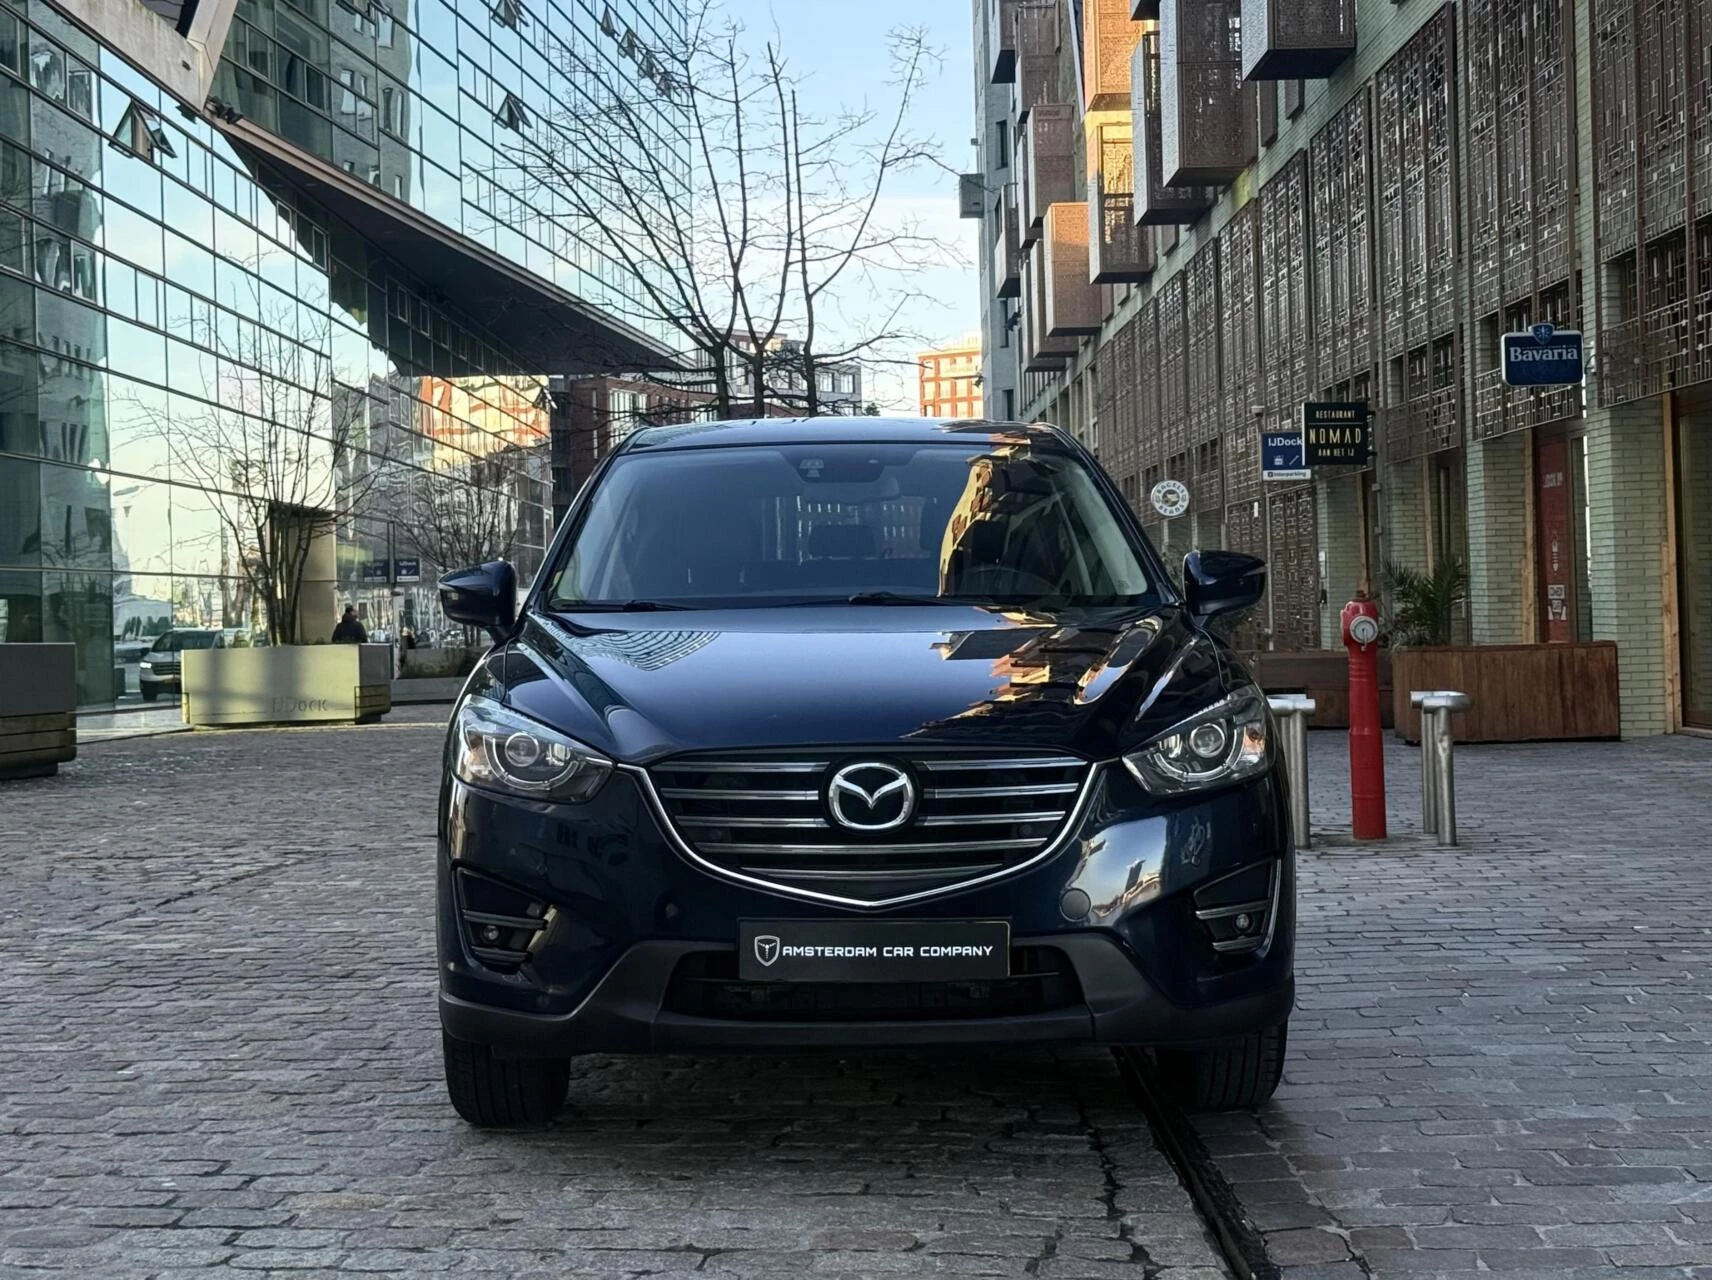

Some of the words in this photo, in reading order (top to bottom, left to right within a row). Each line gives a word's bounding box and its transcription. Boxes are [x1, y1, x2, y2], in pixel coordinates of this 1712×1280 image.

[1509, 344, 1579, 362] Bavaria
[1315, 410, 1355, 419] RESTAURANT
[1268, 436, 1303, 447] IJDock
[1309, 427, 1362, 445] NOMAD
[782, 945, 877, 957] AMSTERDAM
[883, 945, 914, 957] CAR
[920, 945, 994, 957] COMPANY
